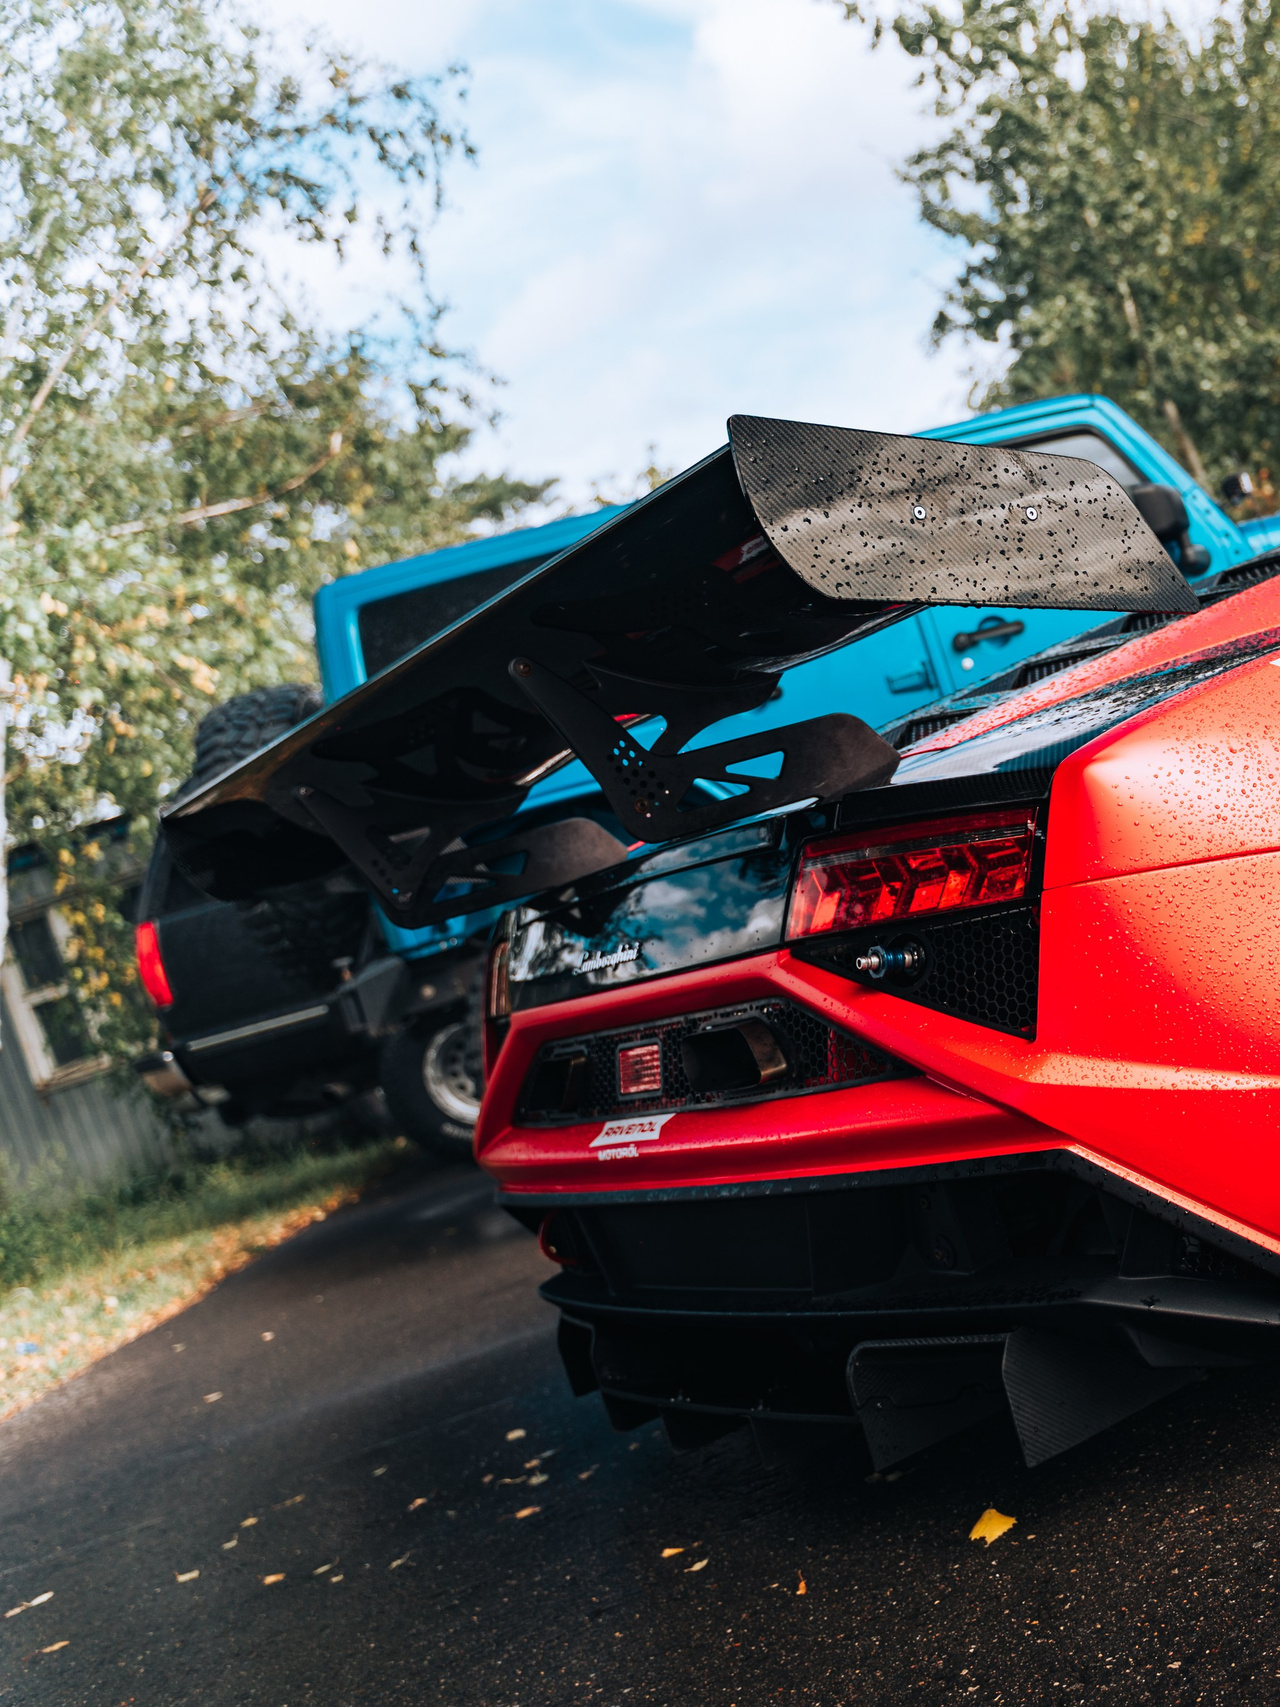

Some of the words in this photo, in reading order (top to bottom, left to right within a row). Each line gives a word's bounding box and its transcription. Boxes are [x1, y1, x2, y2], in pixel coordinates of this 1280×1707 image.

[572, 942, 640, 976] Lamborghini
[603, 1121, 657, 1137] RAVENOL
[598, 1144, 639, 1161] MOTORÖL
